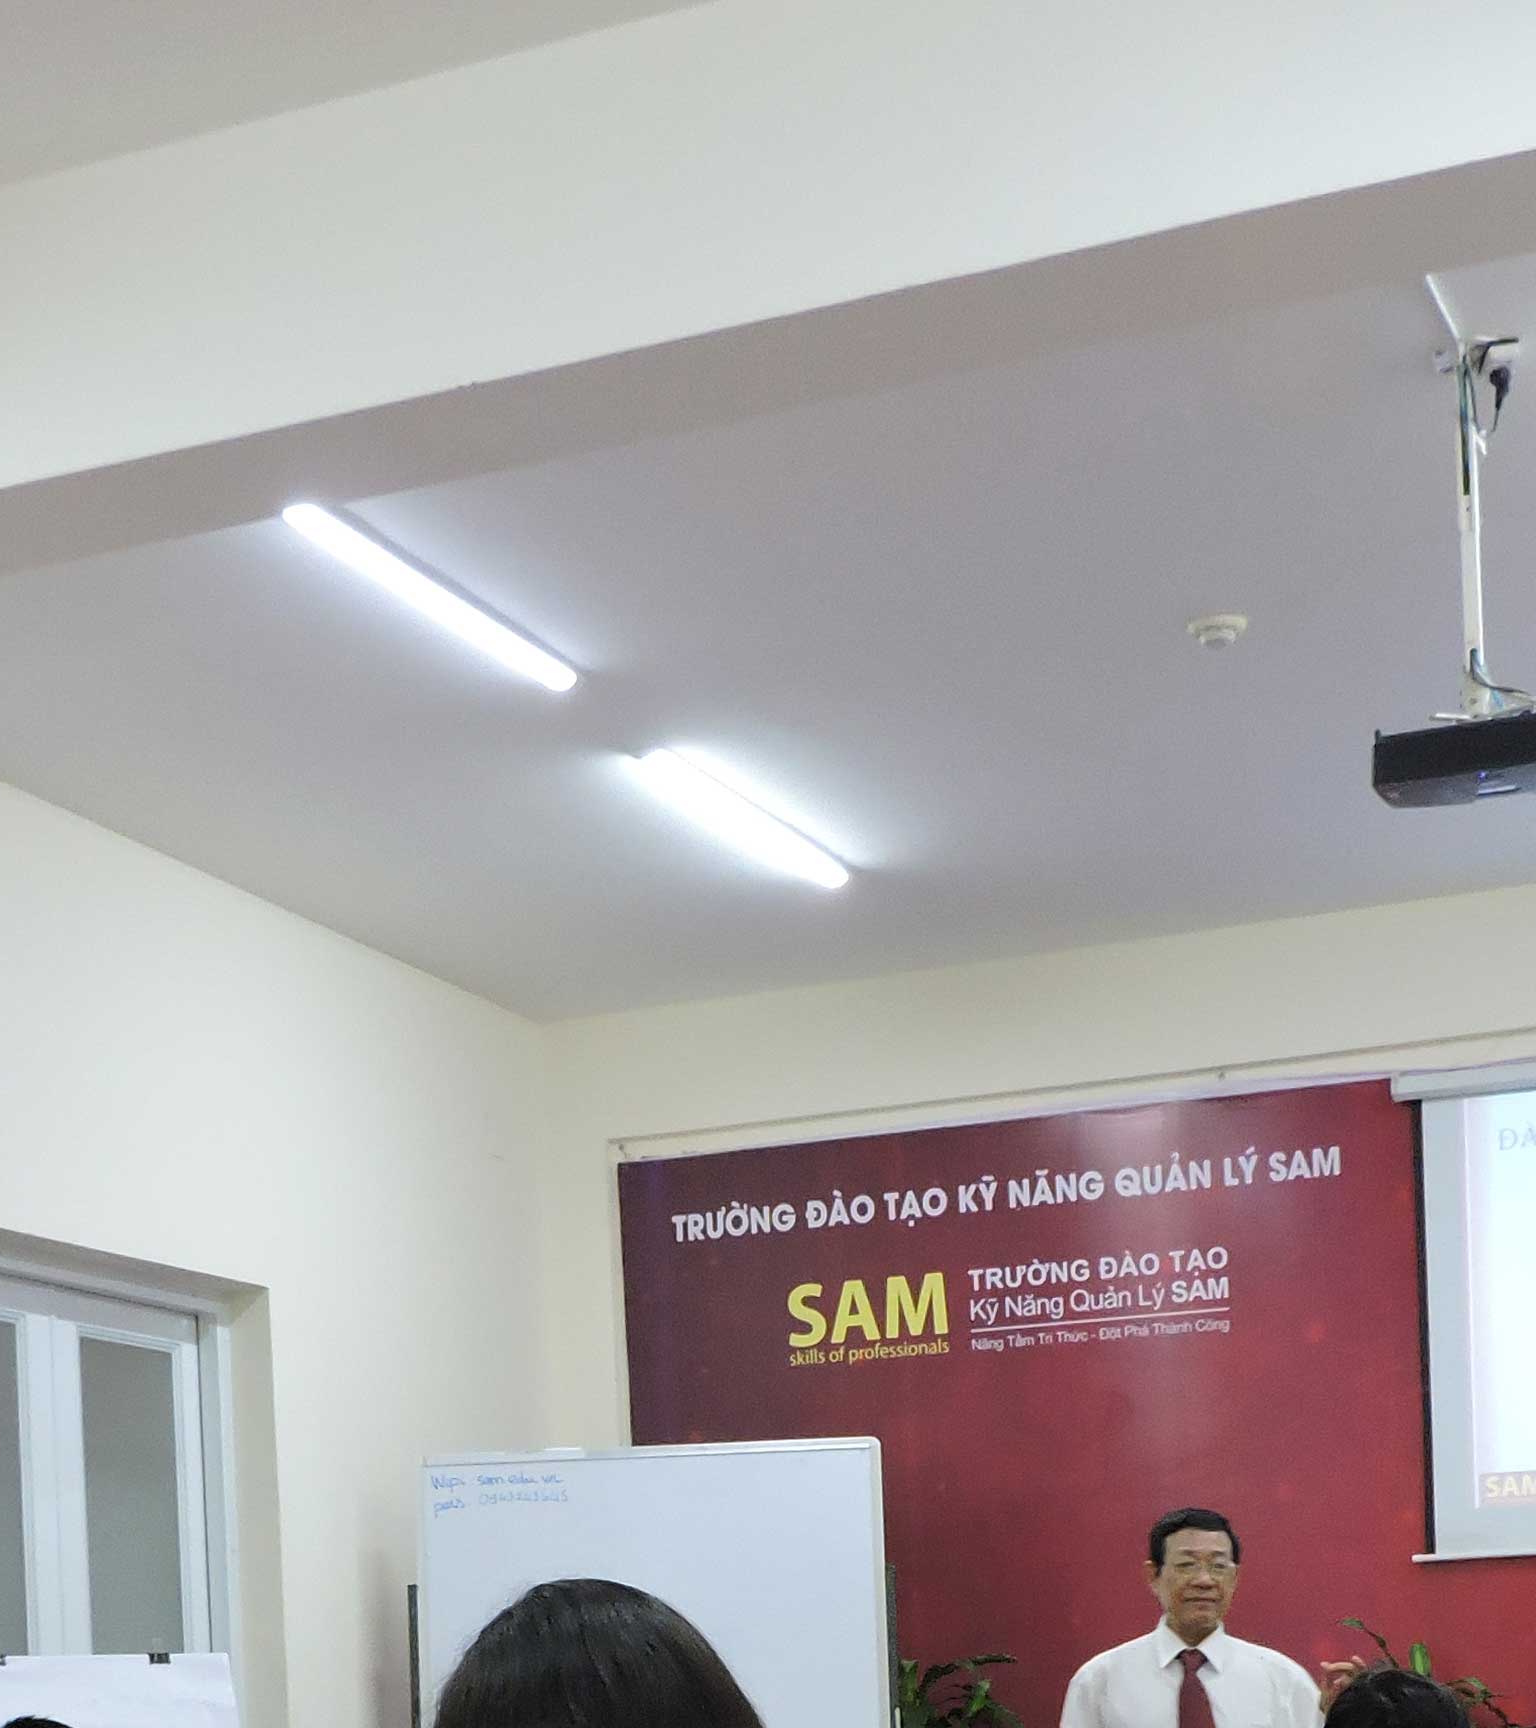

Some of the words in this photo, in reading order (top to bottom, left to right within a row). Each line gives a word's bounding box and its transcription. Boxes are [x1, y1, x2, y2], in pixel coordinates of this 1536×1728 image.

[671, 1200, 797, 1243] TRƯỜNG
[804, 1188, 876, 1230] ĐÀO
[882, 1186, 949, 1228] TẠO
[957, 1174, 999, 1214] KỸ
[1006, 1168, 1105, 1209] NĂNG
[1114, 1151, 1212, 1197] QUẢN
[1222, 1145, 1259, 1187] LÝ
[1268, 1145, 1342, 1183] SAM
[967, 1257, 1091, 1292] TRƯỜNG
[1098, 1250, 1161, 1280] ĐÀO
[1168, 1246, 1229, 1276] TẠO
[787, 1271, 949, 1348] SAM
[969, 1297, 1000, 1326] Kỹ
[1004, 1294, 1065, 1319] Năng
[1069, 1285, 1133, 1312] Quản
[1137, 1282, 1165, 1311] Lý
[1170, 1276, 1230, 1304] SAM
[789, 1347, 826, 1367] skills
[829, 1345, 846, 1363] of
[848, 1338, 950, 1365] professionals
